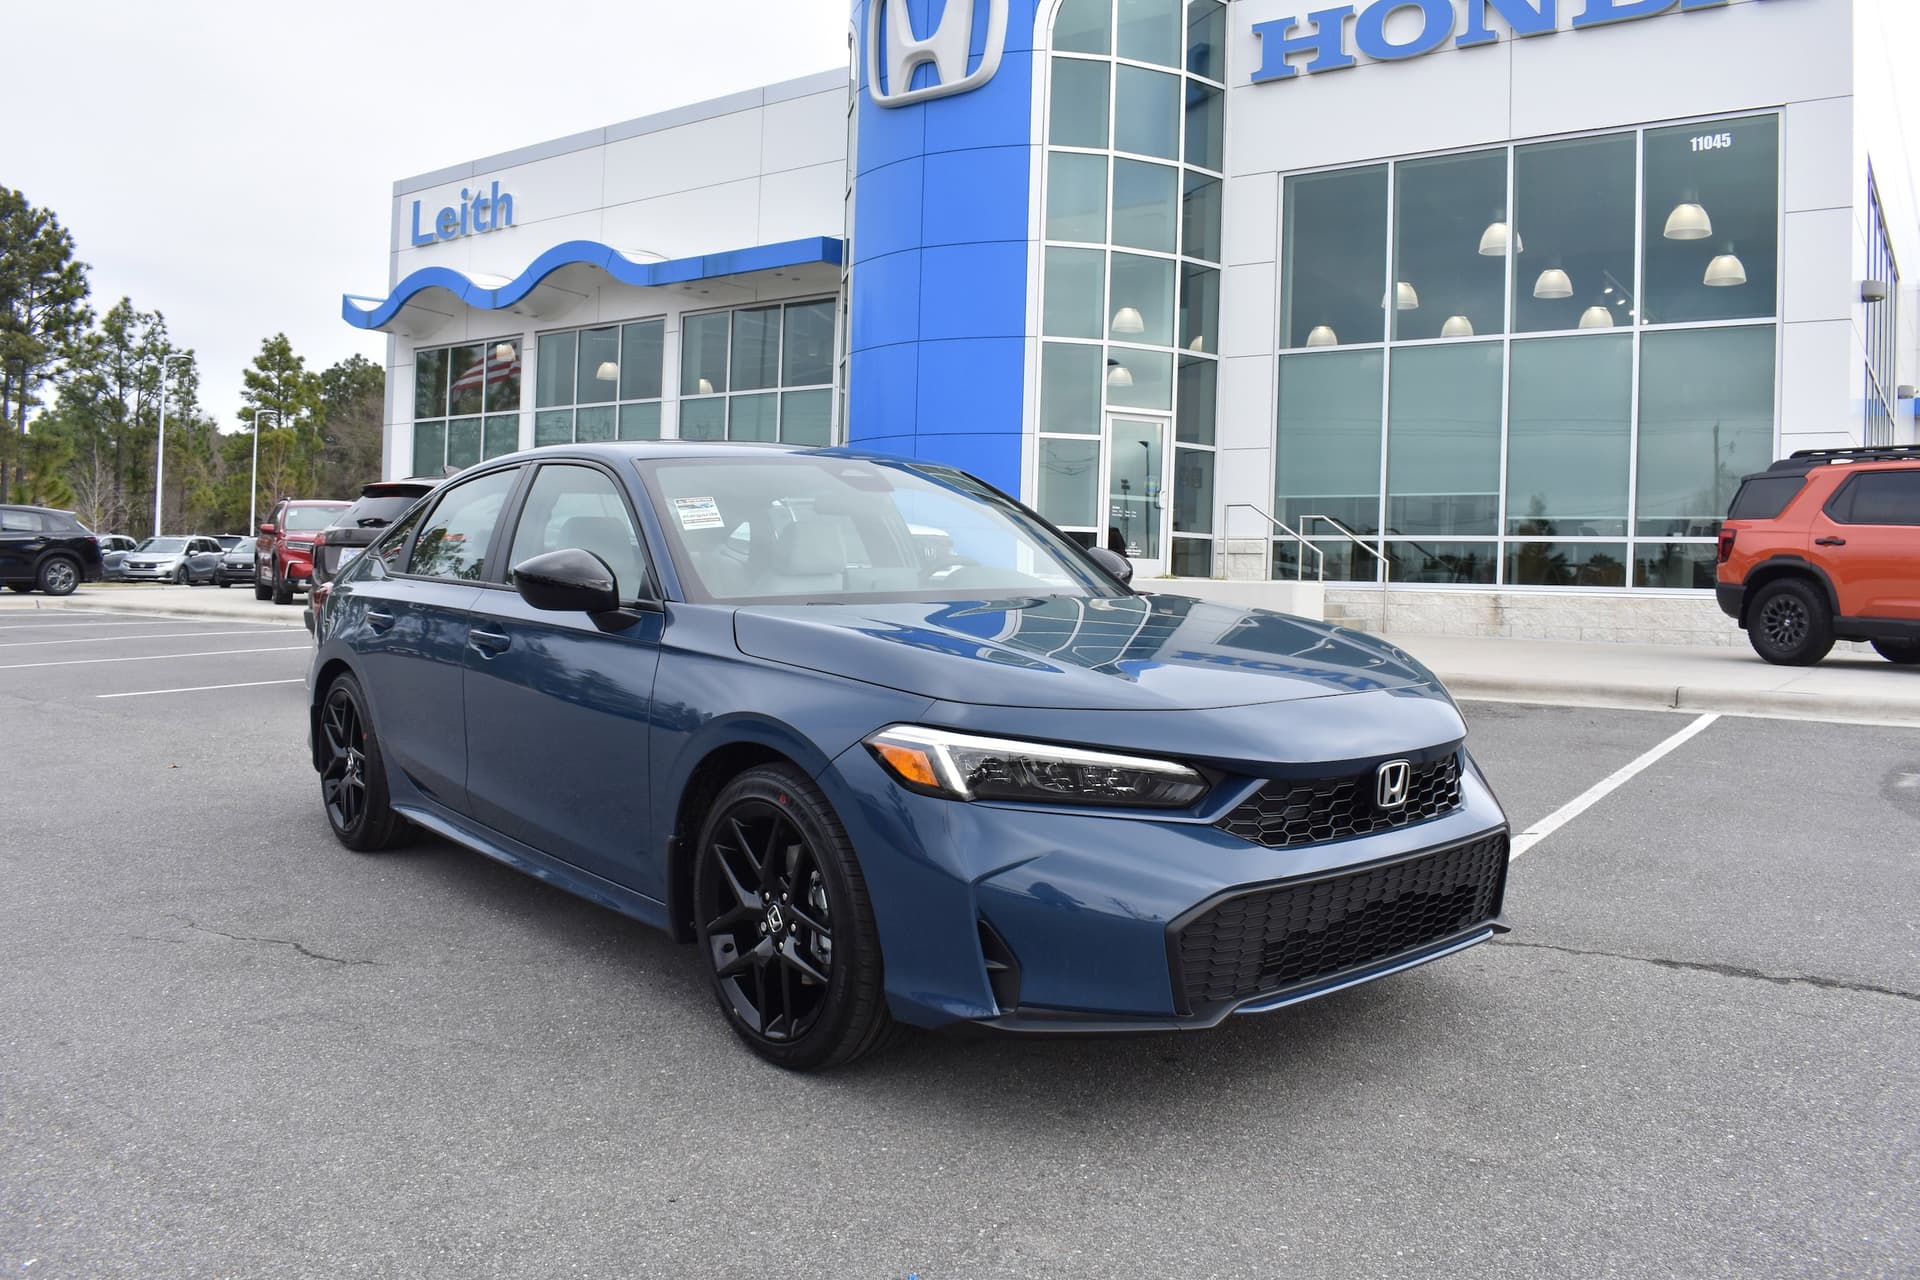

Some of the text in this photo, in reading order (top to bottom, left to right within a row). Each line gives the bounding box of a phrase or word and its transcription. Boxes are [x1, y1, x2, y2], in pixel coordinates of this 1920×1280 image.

[1251, 0, 1785, 83] HON
[1690, 133, 1731, 152] 11045
[411, 180, 514, 247] Leith
